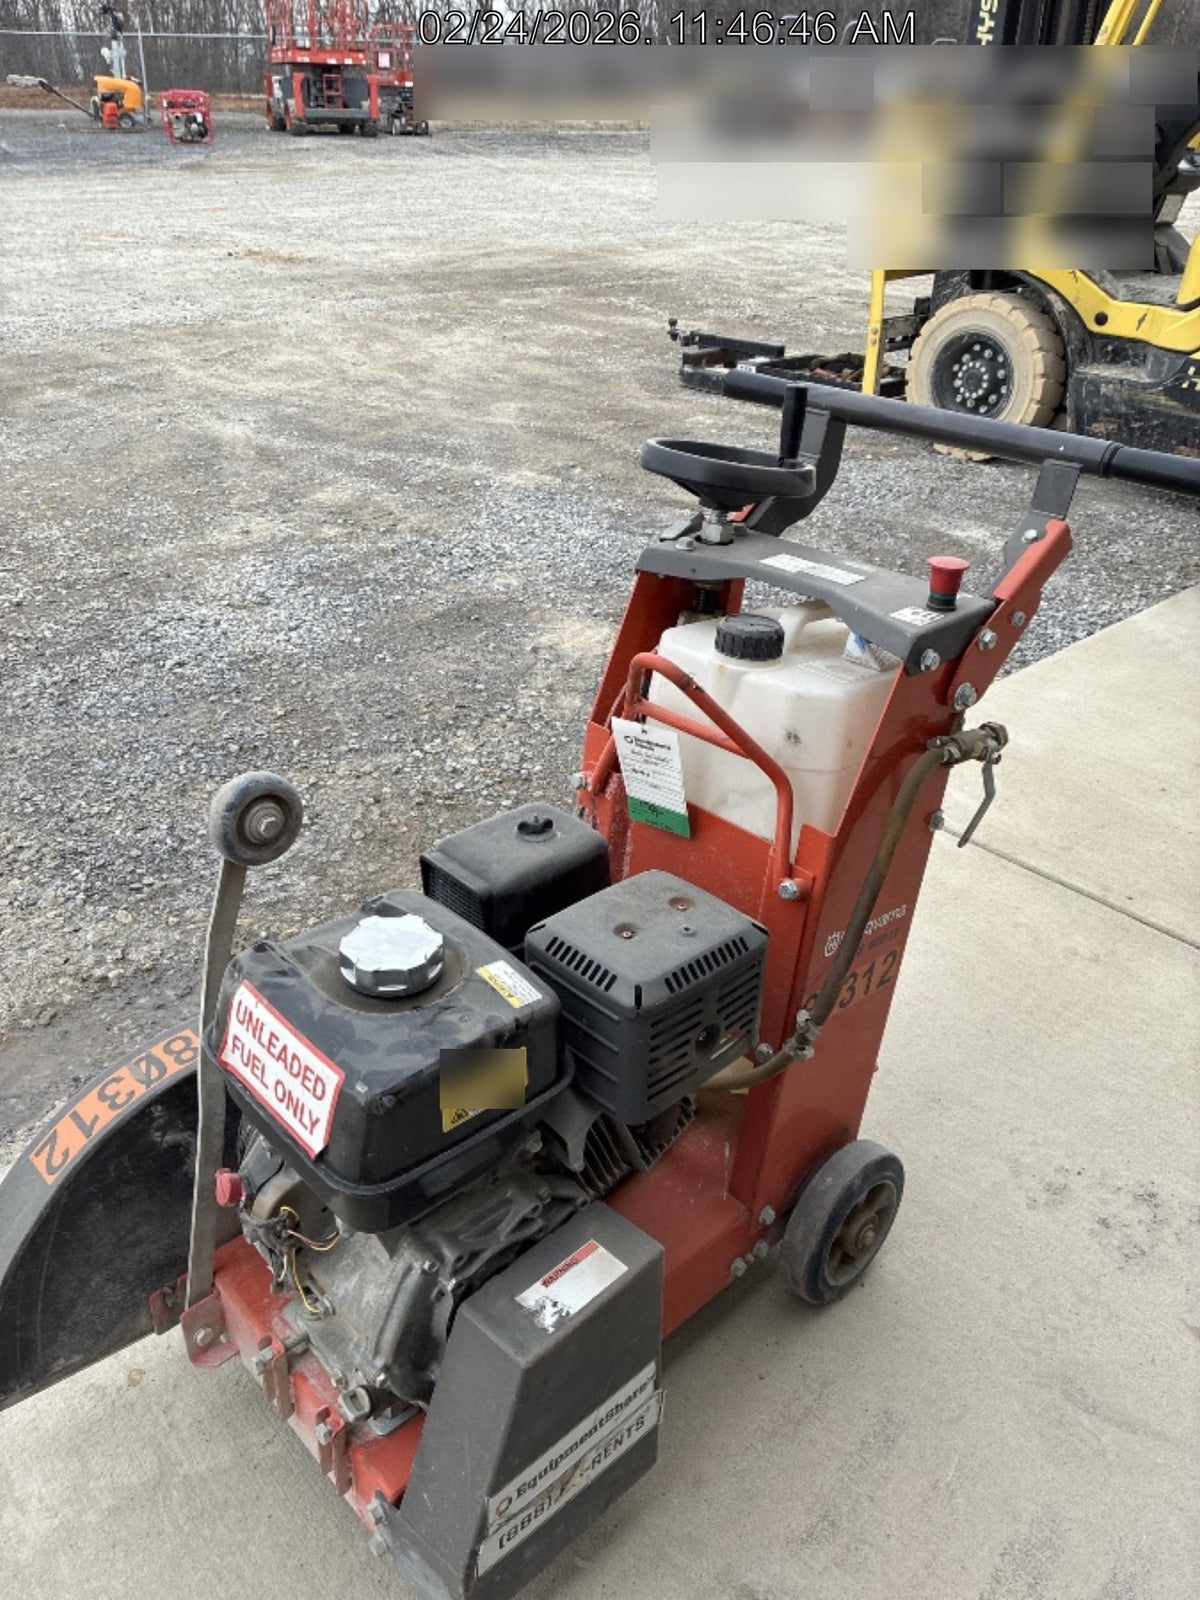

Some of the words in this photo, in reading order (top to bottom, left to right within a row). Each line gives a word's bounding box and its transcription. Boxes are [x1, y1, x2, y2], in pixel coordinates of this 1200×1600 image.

[803, 950, 898, 1010] 312
[231, 1034, 269, 1090] FUEL
[274, 1080, 321, 1136] ONLY
[235, 999, 326, 1102] UNLEADED
[33, 1034, 198, 1177] 80312
